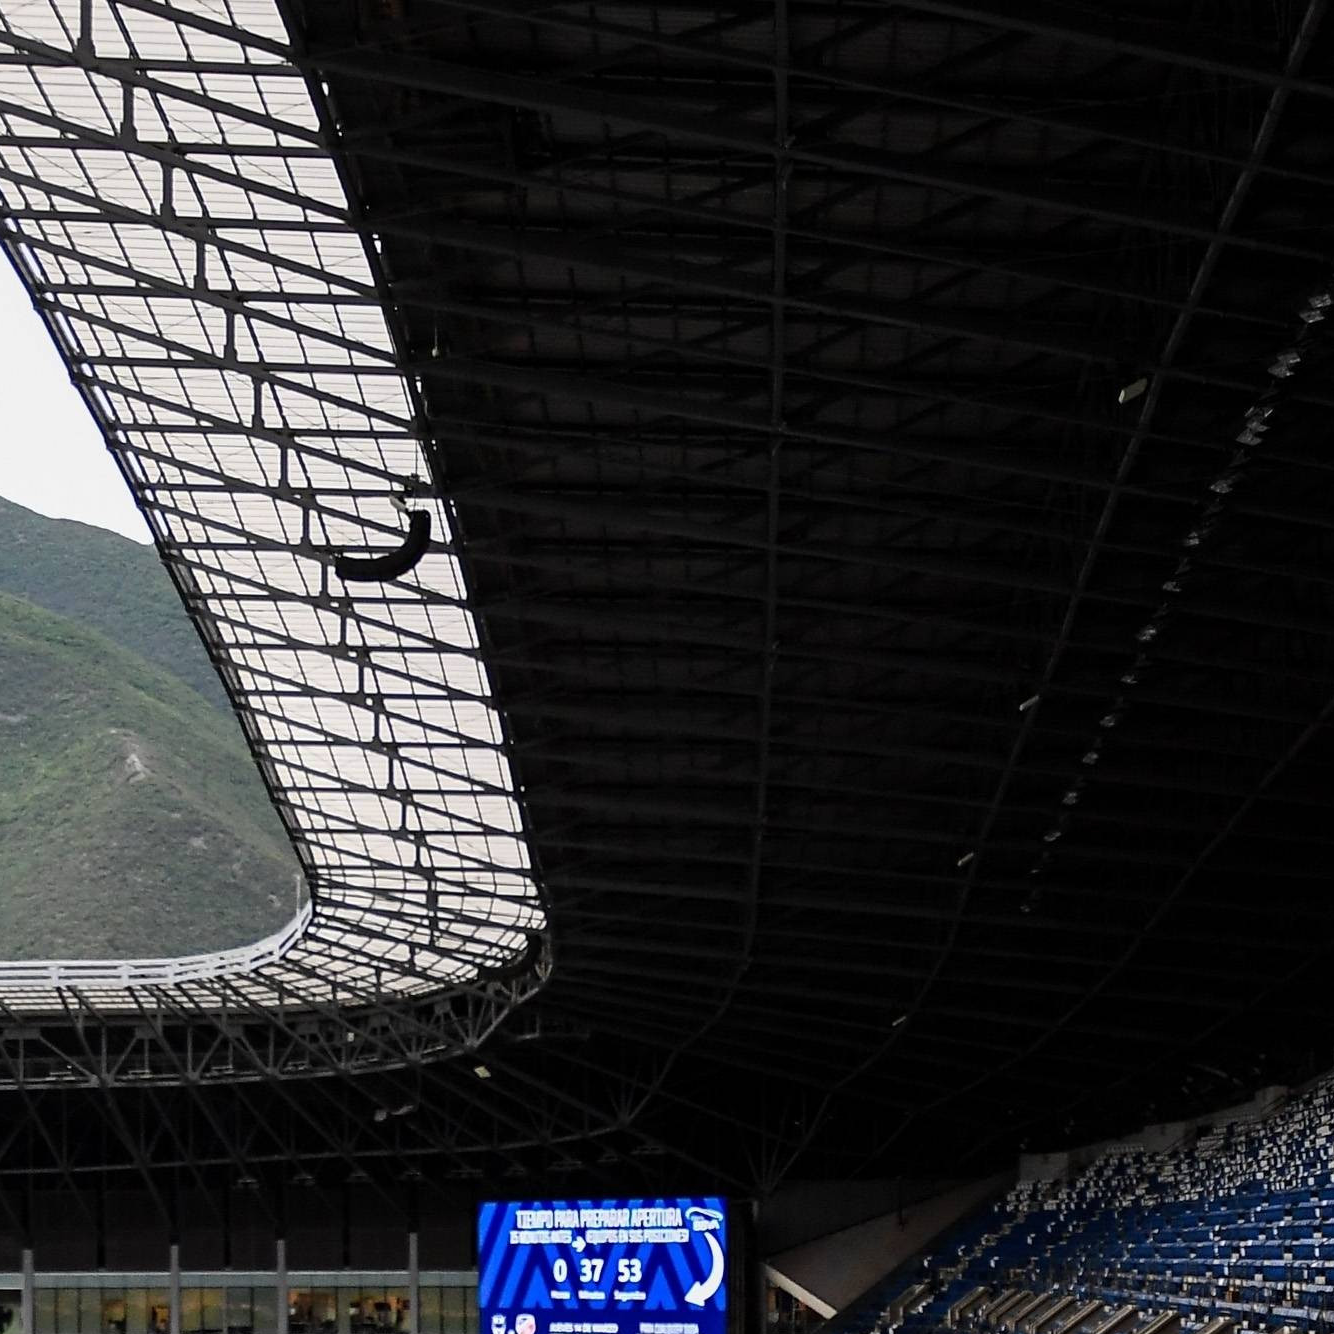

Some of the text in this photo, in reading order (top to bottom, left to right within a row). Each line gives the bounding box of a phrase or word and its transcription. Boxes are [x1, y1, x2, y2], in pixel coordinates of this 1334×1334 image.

[631, 1207, 682, 1227] APERTURA
[553, 1258, 642, 1282] 0 37 53
